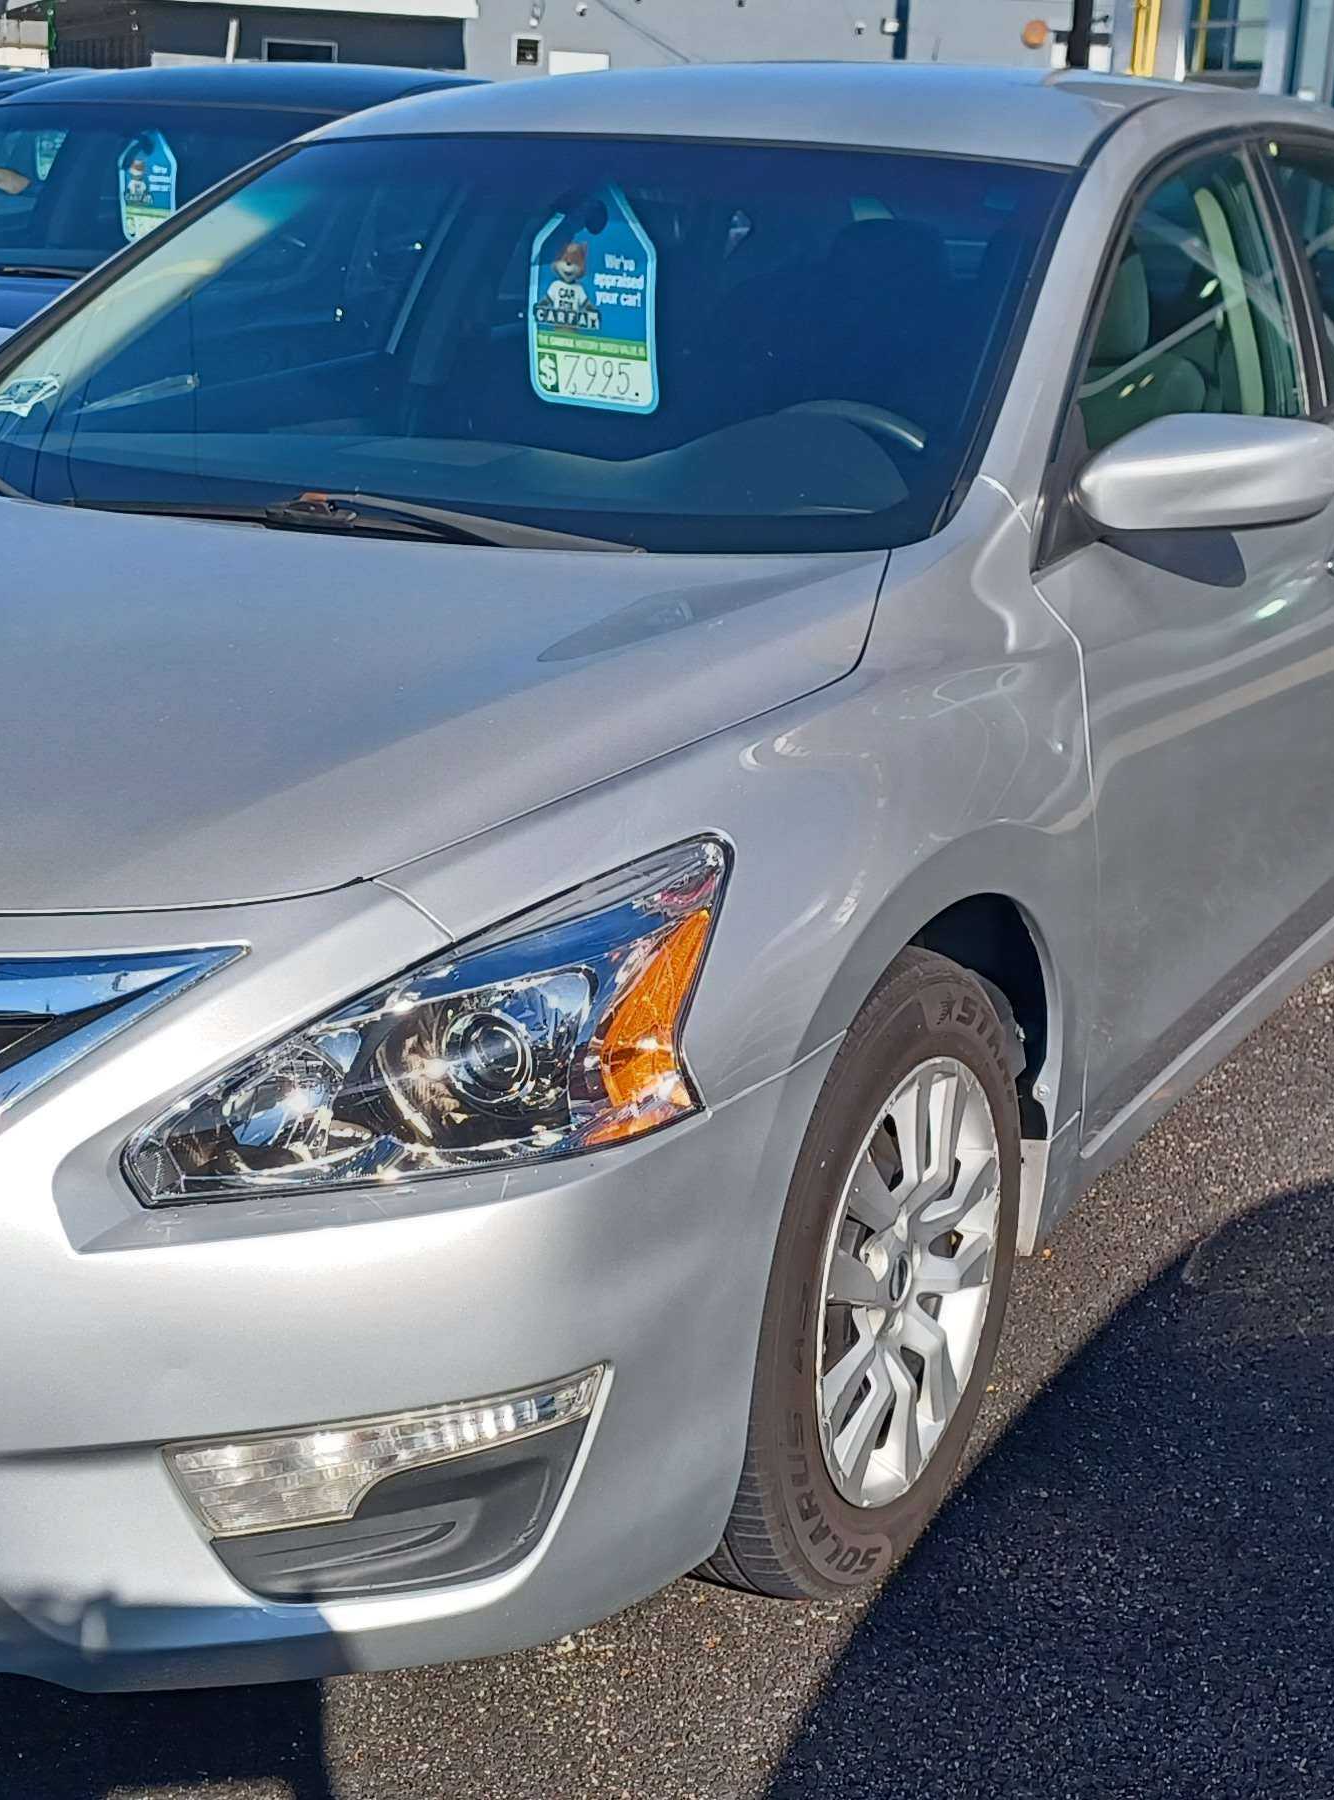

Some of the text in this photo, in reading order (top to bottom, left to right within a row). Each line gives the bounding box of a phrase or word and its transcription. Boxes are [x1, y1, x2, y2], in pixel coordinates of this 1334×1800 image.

[593, 272, 645, 291] appraised
[594, 291, 619, 308] your
[786, 1411, 882, 1576] SOLARUS
